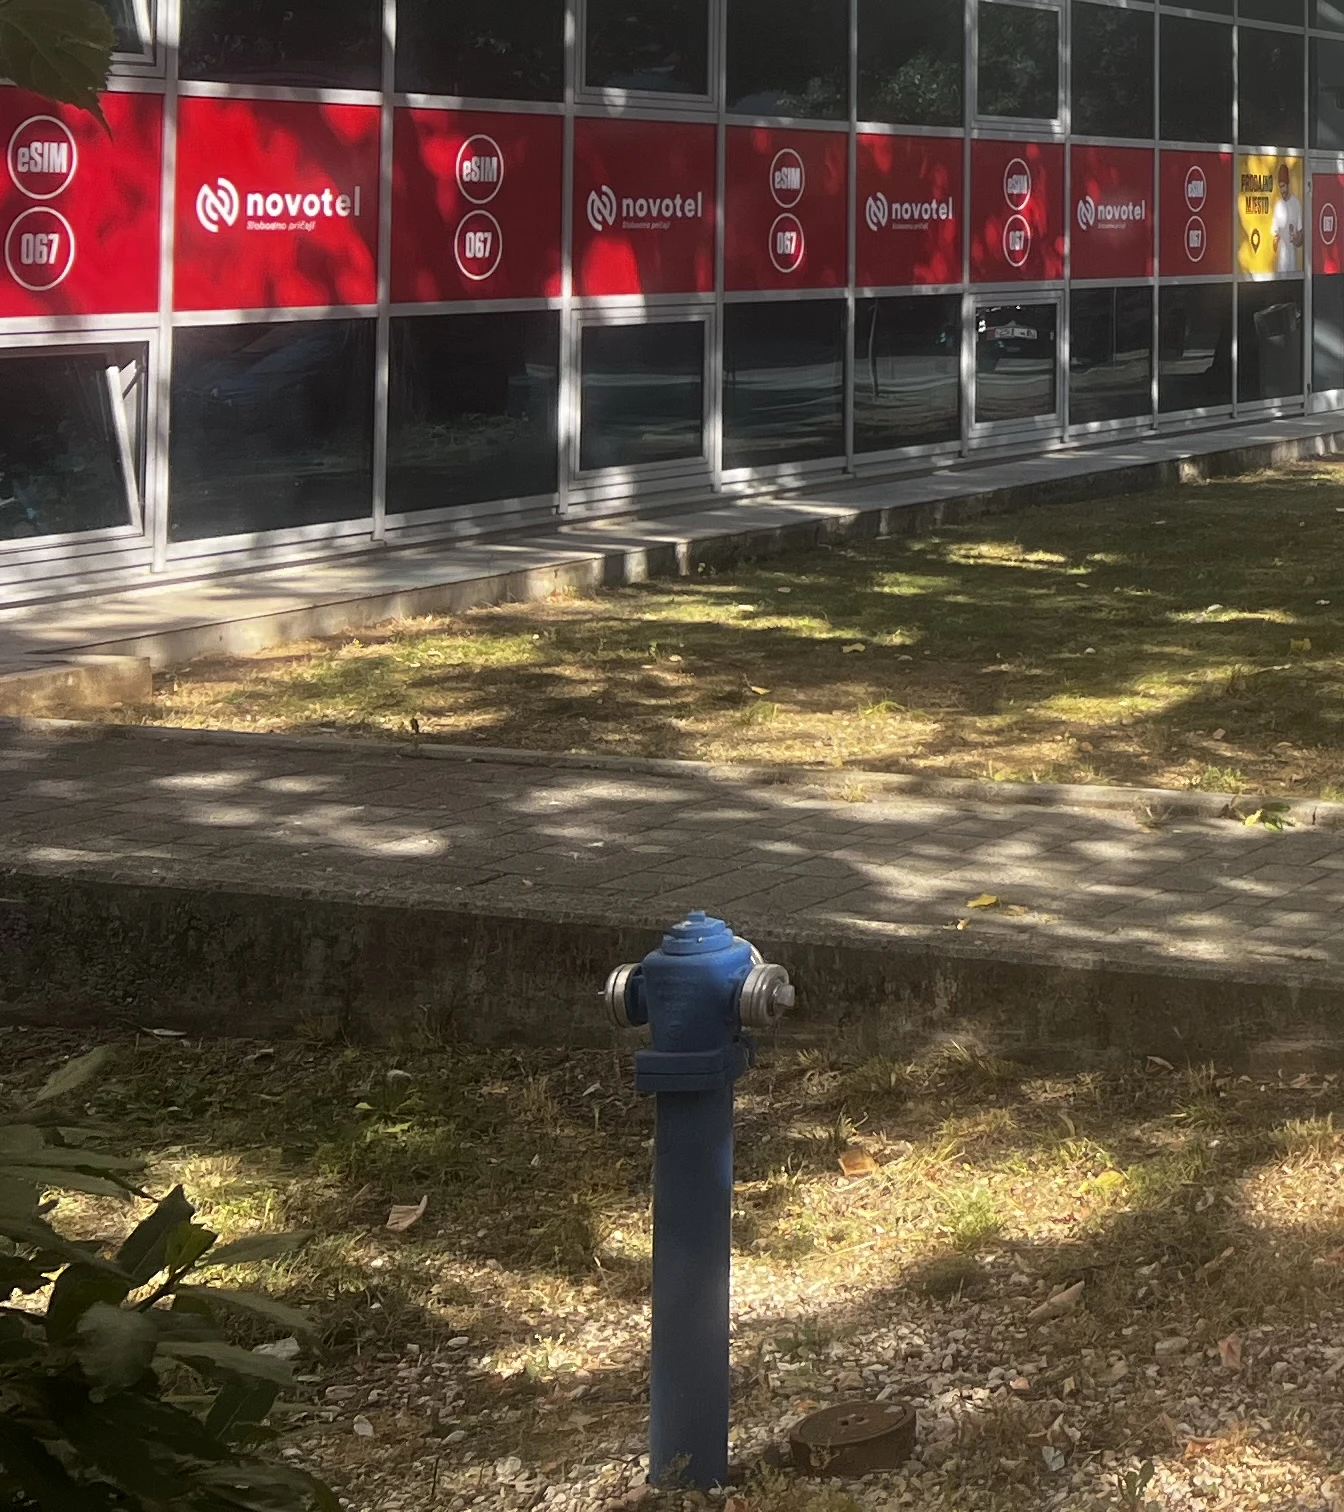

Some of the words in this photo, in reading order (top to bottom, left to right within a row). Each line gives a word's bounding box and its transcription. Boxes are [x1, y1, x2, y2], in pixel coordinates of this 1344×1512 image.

[17, 141, 68, 173] eSIM
[462, 156, 498, 182] eSIM
[774, 167, 801, 190] eSIM
[246, 186, 361, 217] novotel
[621, 191, 703, 218] novotel
[891, 196, 953, 220] novotel
[1097, 199, 1146, 220] novotel
[20, 233, 60, 265] 067
[465, 231, 493, 258] 067
[776, 231, 797, 255] 067
